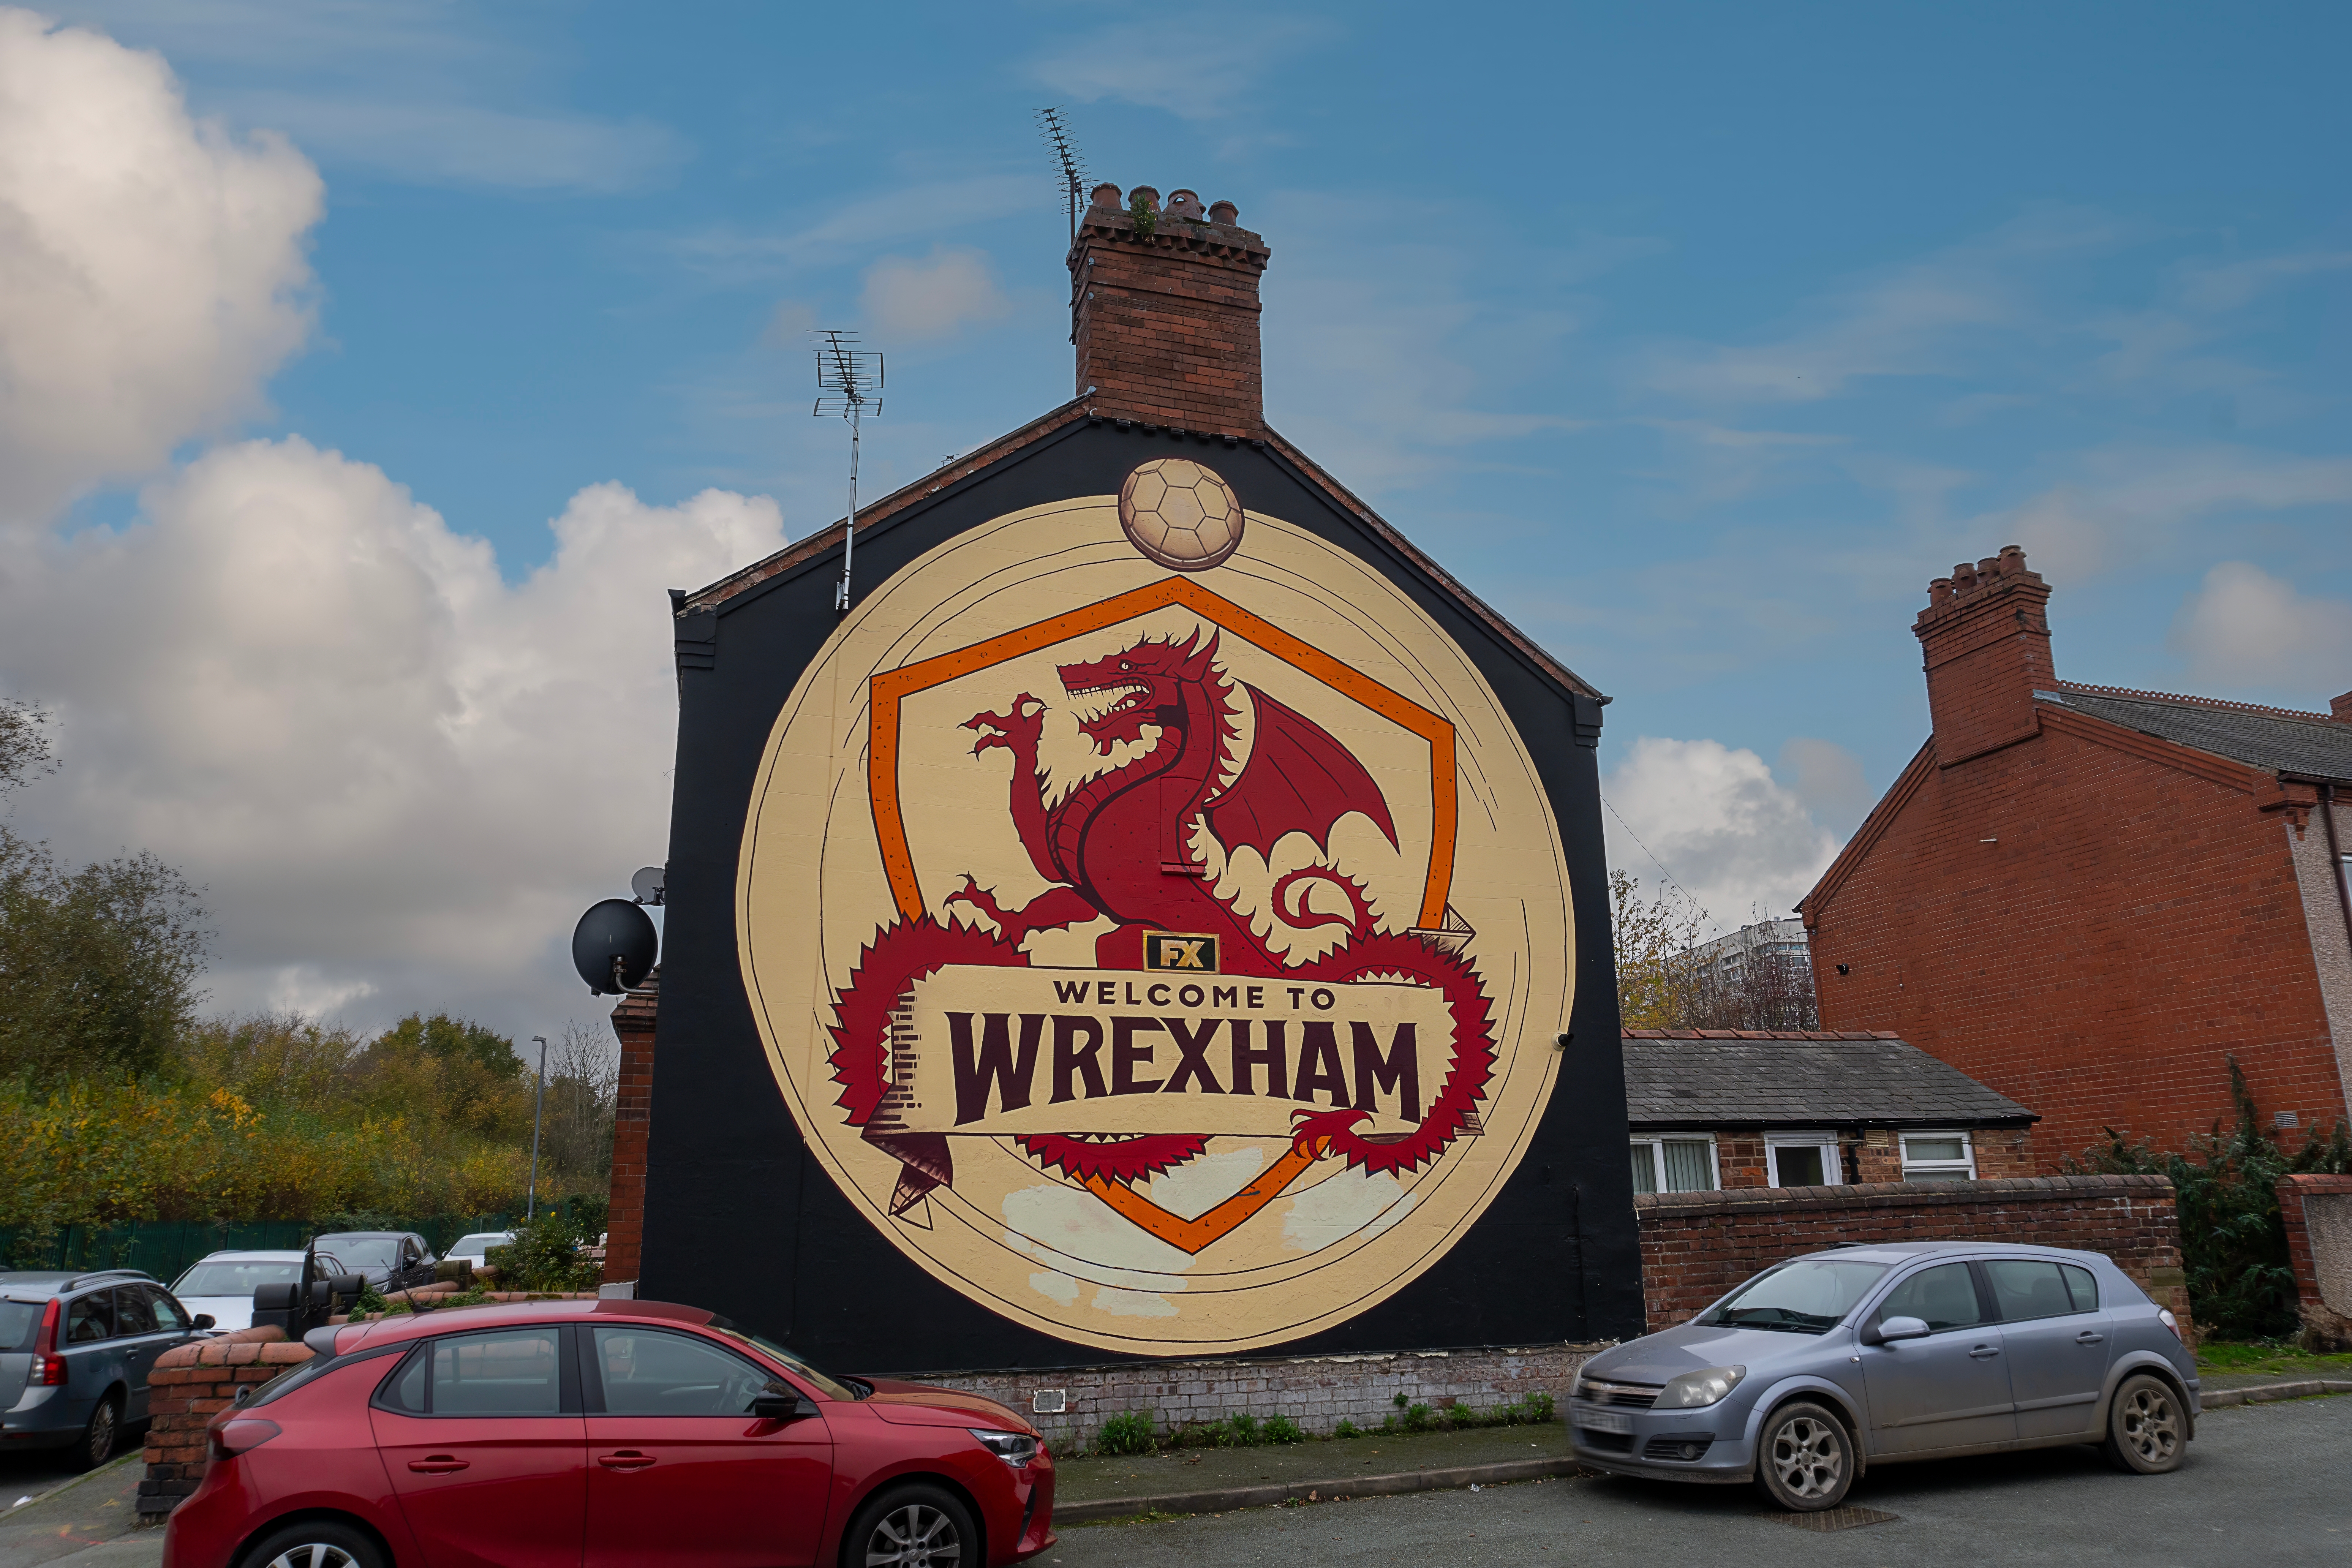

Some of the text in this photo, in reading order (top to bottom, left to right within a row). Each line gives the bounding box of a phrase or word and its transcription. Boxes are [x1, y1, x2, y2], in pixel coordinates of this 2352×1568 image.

[1160, 939, 1205, 967] FX
[1053, 980, 1335, 1010] WELCOME TO
[943, 1011, 1421, 1128] WREXHAM
